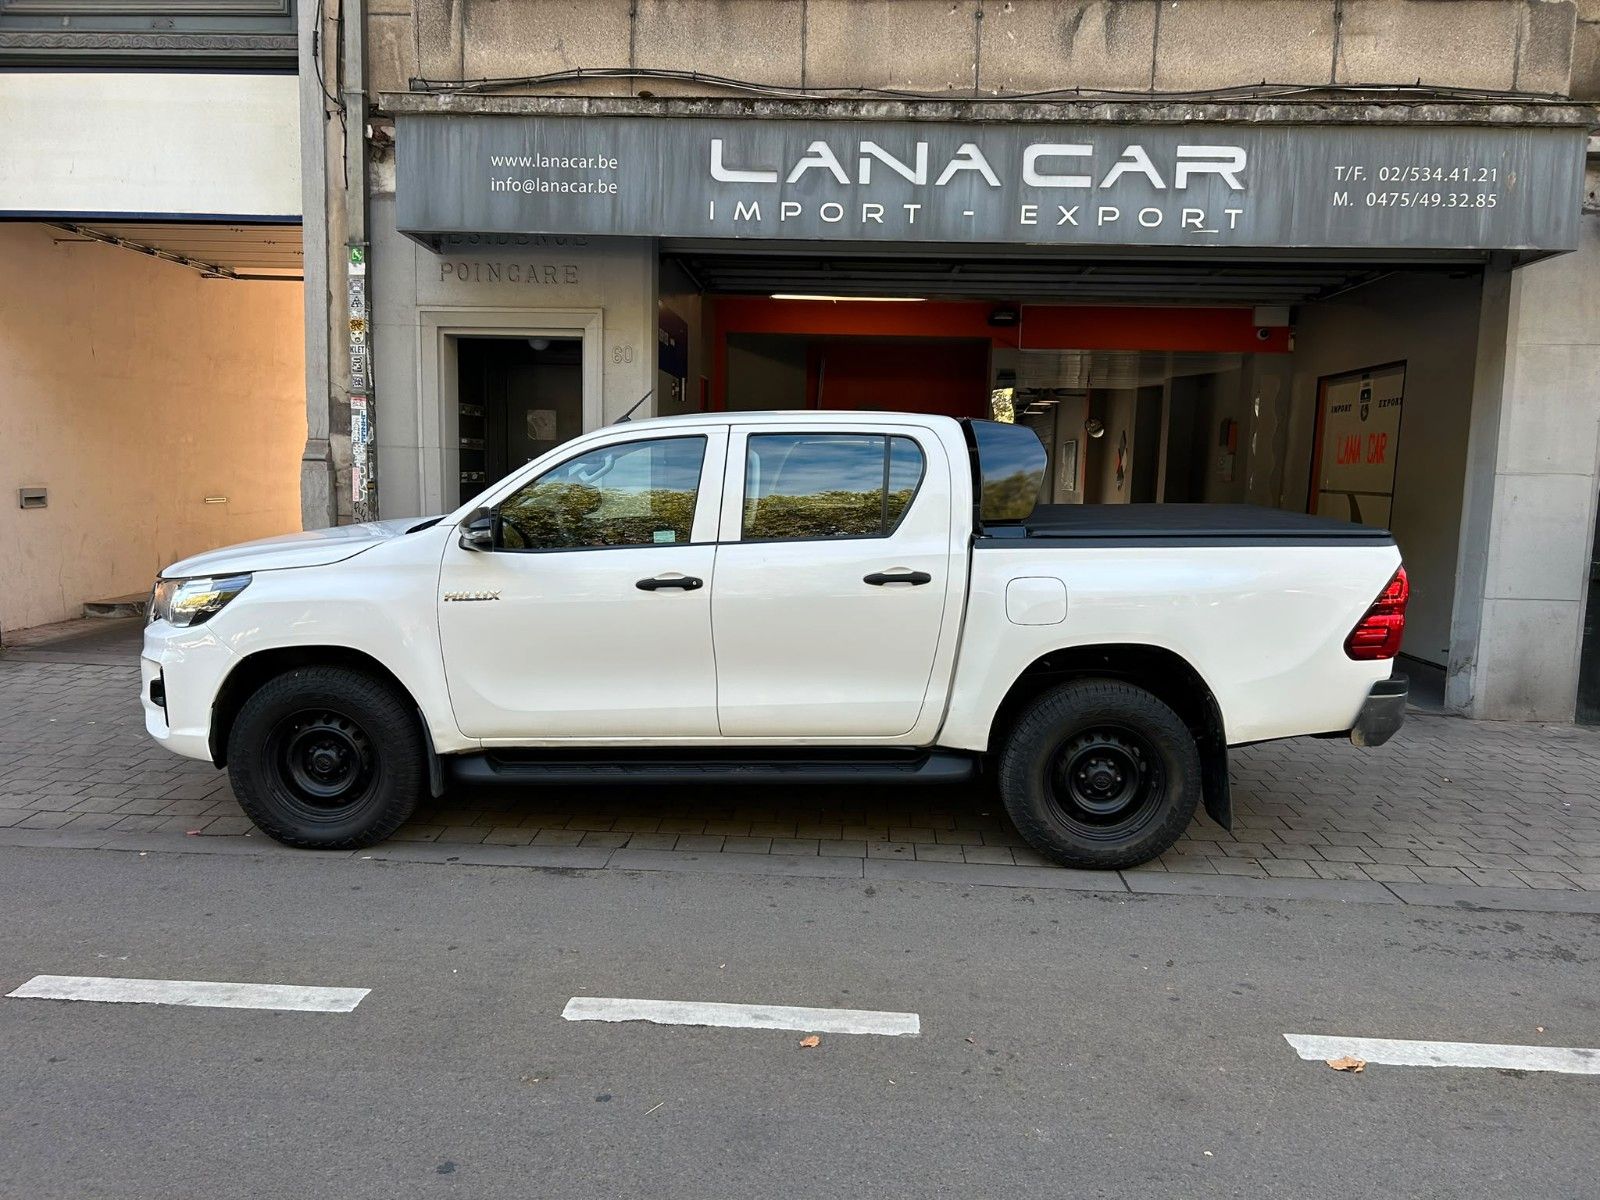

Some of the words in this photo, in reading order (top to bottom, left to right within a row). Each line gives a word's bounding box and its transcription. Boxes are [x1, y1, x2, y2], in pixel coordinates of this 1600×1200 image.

[490, 152, 618, 169] www.lanacar.be
[710, 139, 1002, 186] LANA
[1022, 143, 1246, 190] CAR
[1334, 166, 1367, 181] T/F.
[1379, 166, 1497, 182] 02/534.41.21
[490, 176, 618, 194] info@lanacar.be
[1332, 191, 1354, 207] M.
[1366, 192, 1497, 208] 0475/49.32.85
[709, 200, 922, 224] IMPORT
[1020, 205, 1244, 230] EXPORT
[611, 345, 633, 364] 60
[1336, 433, 1361, 465] LANA
[1366, 432, 1388, 465] CAR
